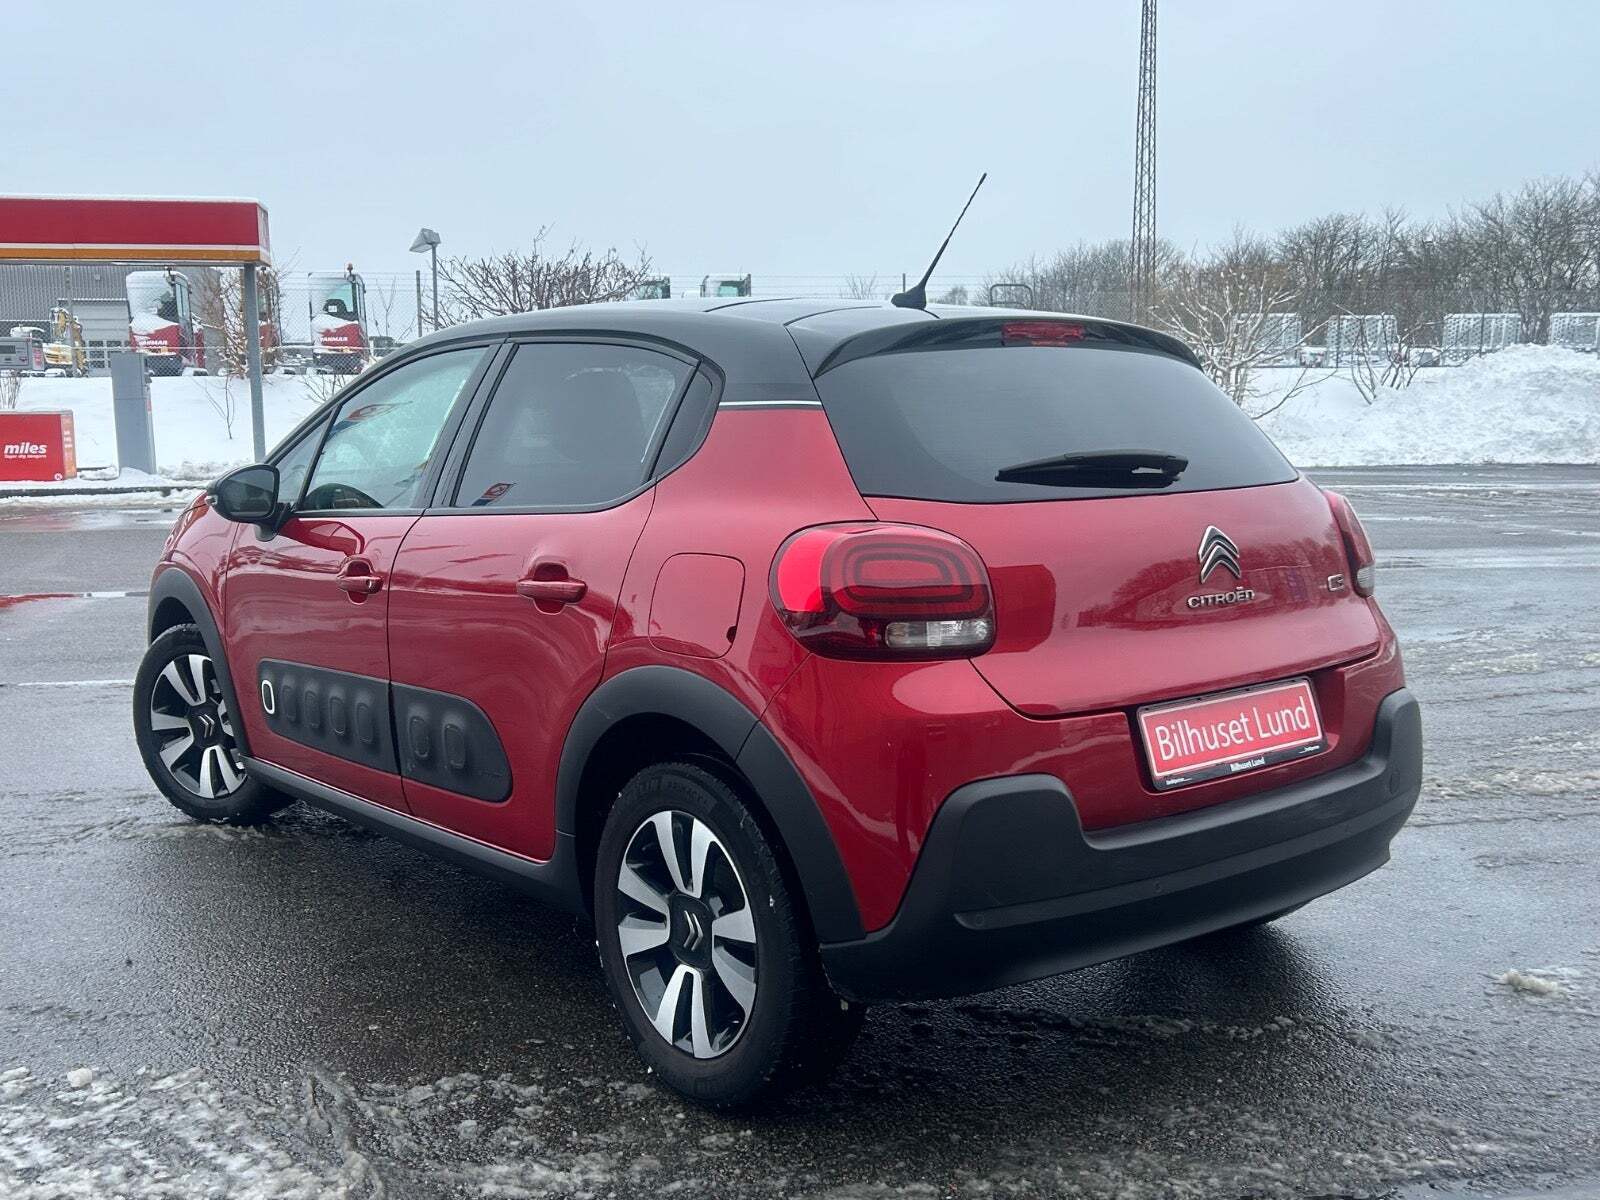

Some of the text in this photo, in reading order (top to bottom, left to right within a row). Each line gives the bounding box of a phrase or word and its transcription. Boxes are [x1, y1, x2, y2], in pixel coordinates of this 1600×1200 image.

[4, 442, 47, 455] miles
[1155, 696, 1311, 761] Bilhuset Lund
